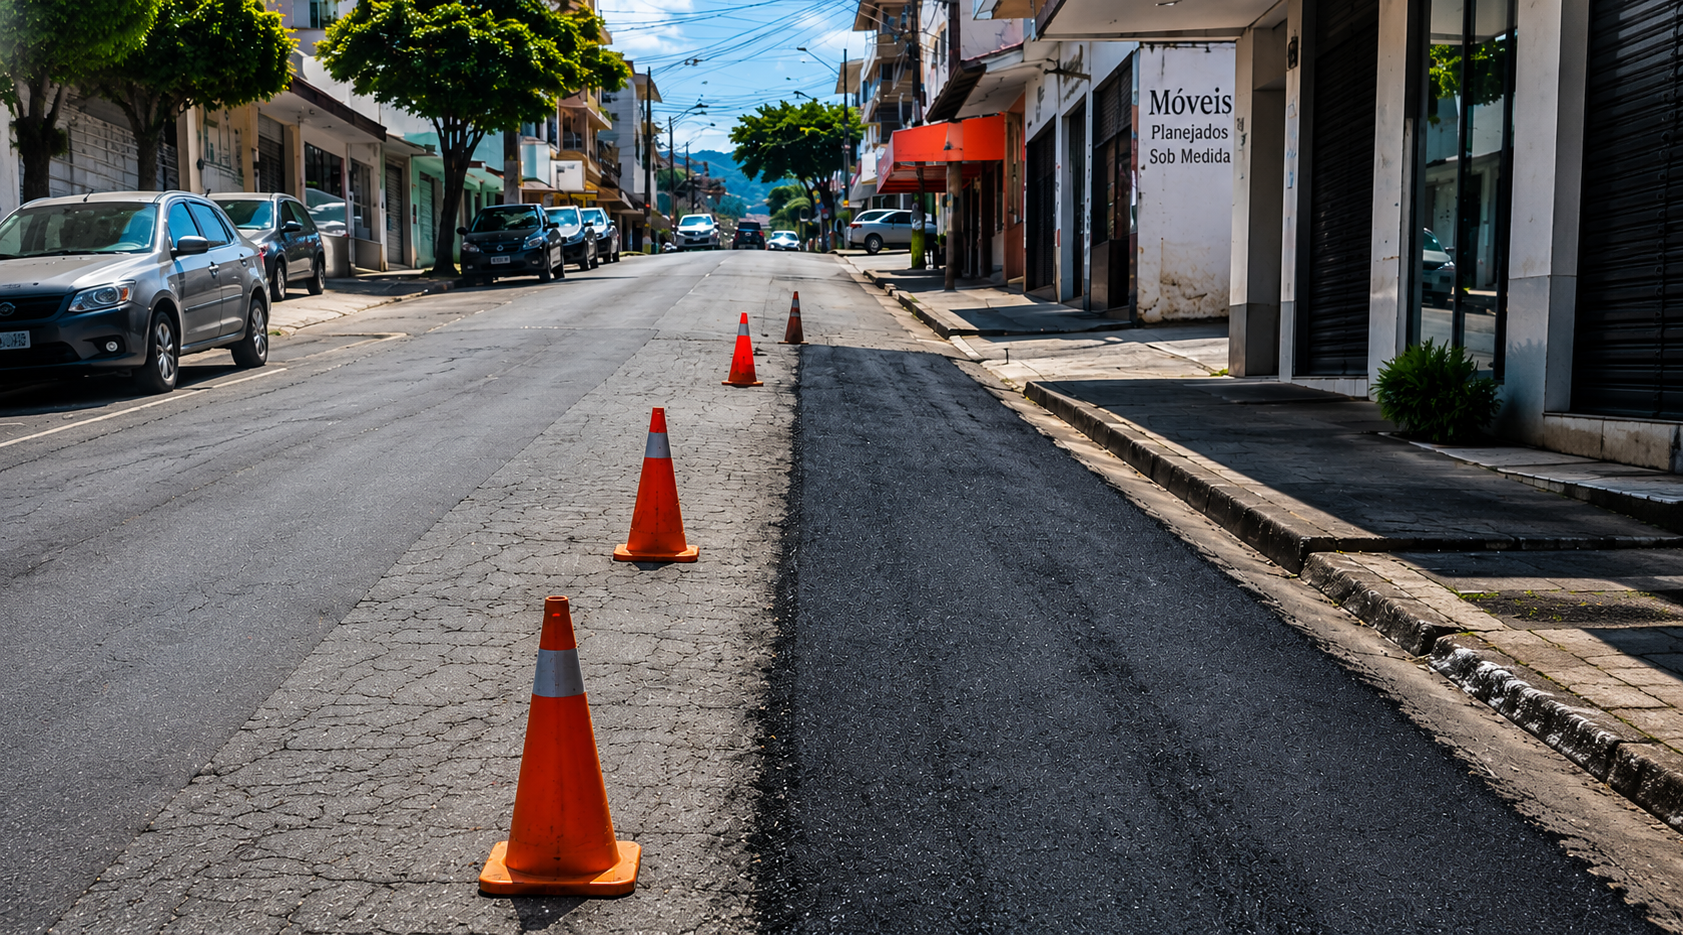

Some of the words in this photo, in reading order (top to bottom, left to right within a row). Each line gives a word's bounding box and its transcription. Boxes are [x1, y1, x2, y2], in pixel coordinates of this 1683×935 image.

[1149, 87, 1232, 115] Móveis
[1151, 123, 1229, 143] Planejados
[1149, 148, 1176, 164] Sob
[1181, 148, 1231, 164] Medida
